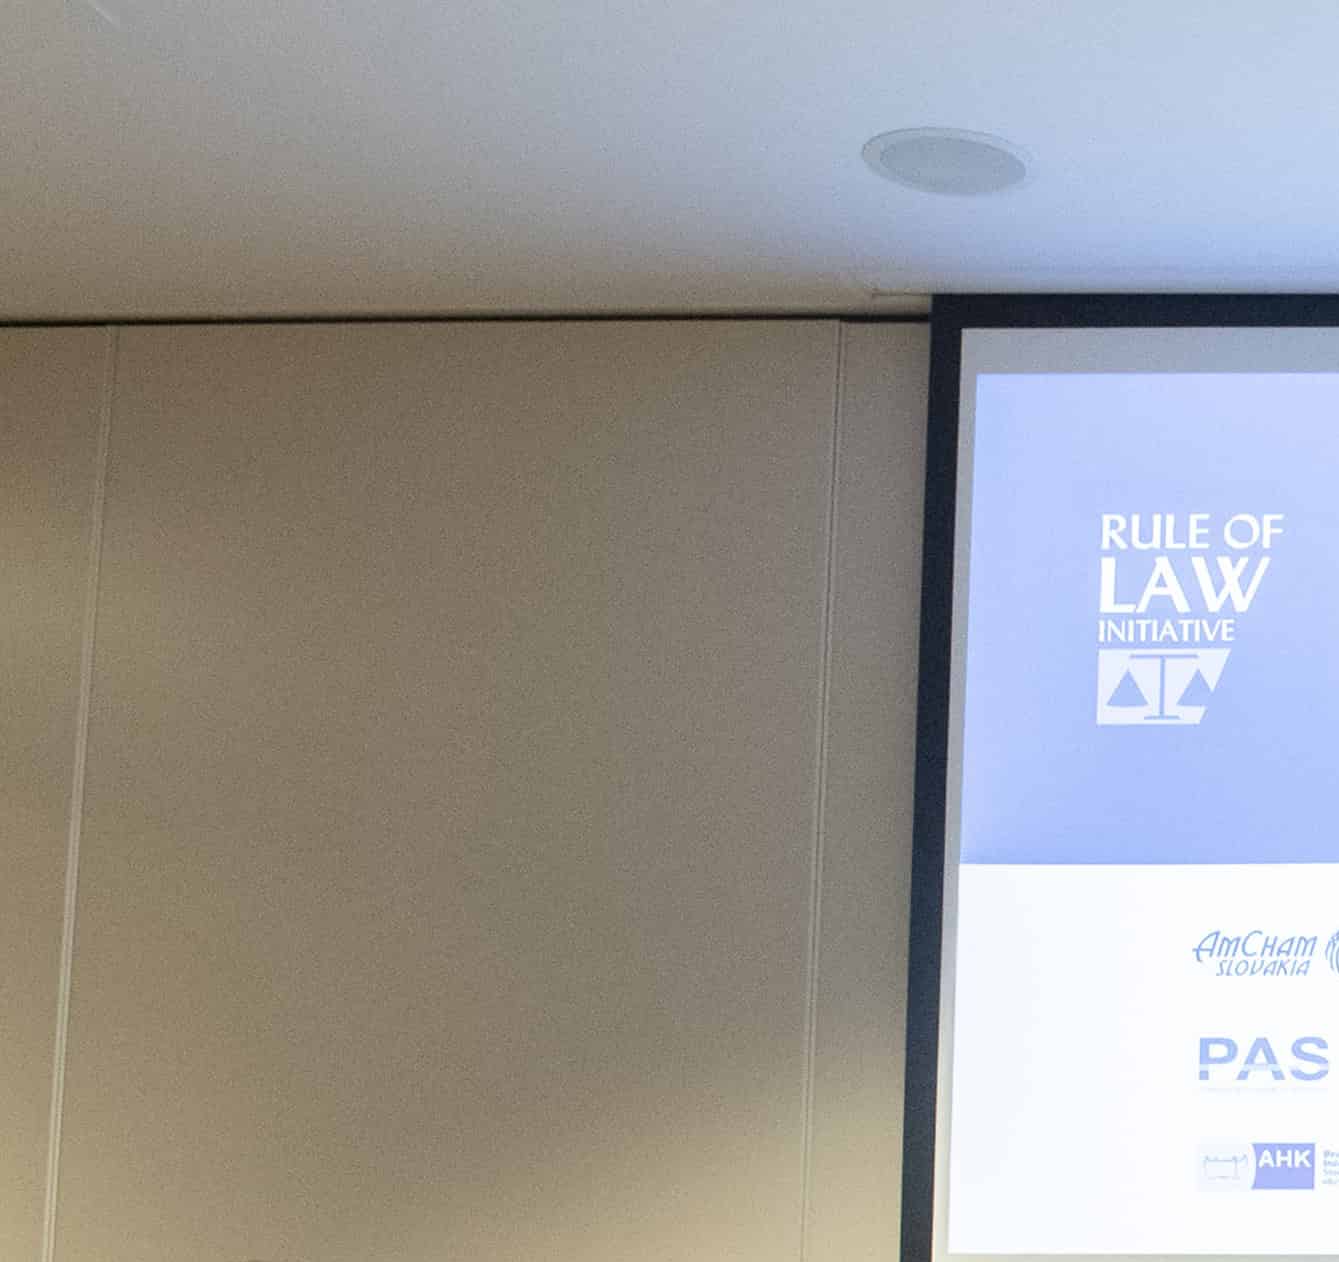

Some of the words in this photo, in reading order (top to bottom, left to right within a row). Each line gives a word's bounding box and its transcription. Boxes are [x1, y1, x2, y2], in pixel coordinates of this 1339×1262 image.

[1100, 513, 1211, 549] RULE
[1223, 513, 1284, 549] OF
[1099, 556, 1271, 613] LAW
[1099, 619, 1235, 642] INITIATIVE
[1216, 960, 1311, 977] SLOVAKIA
[1198, 1036, 1329, 1081] PAS
[1256, 1149, 1312, 1168] AHK
